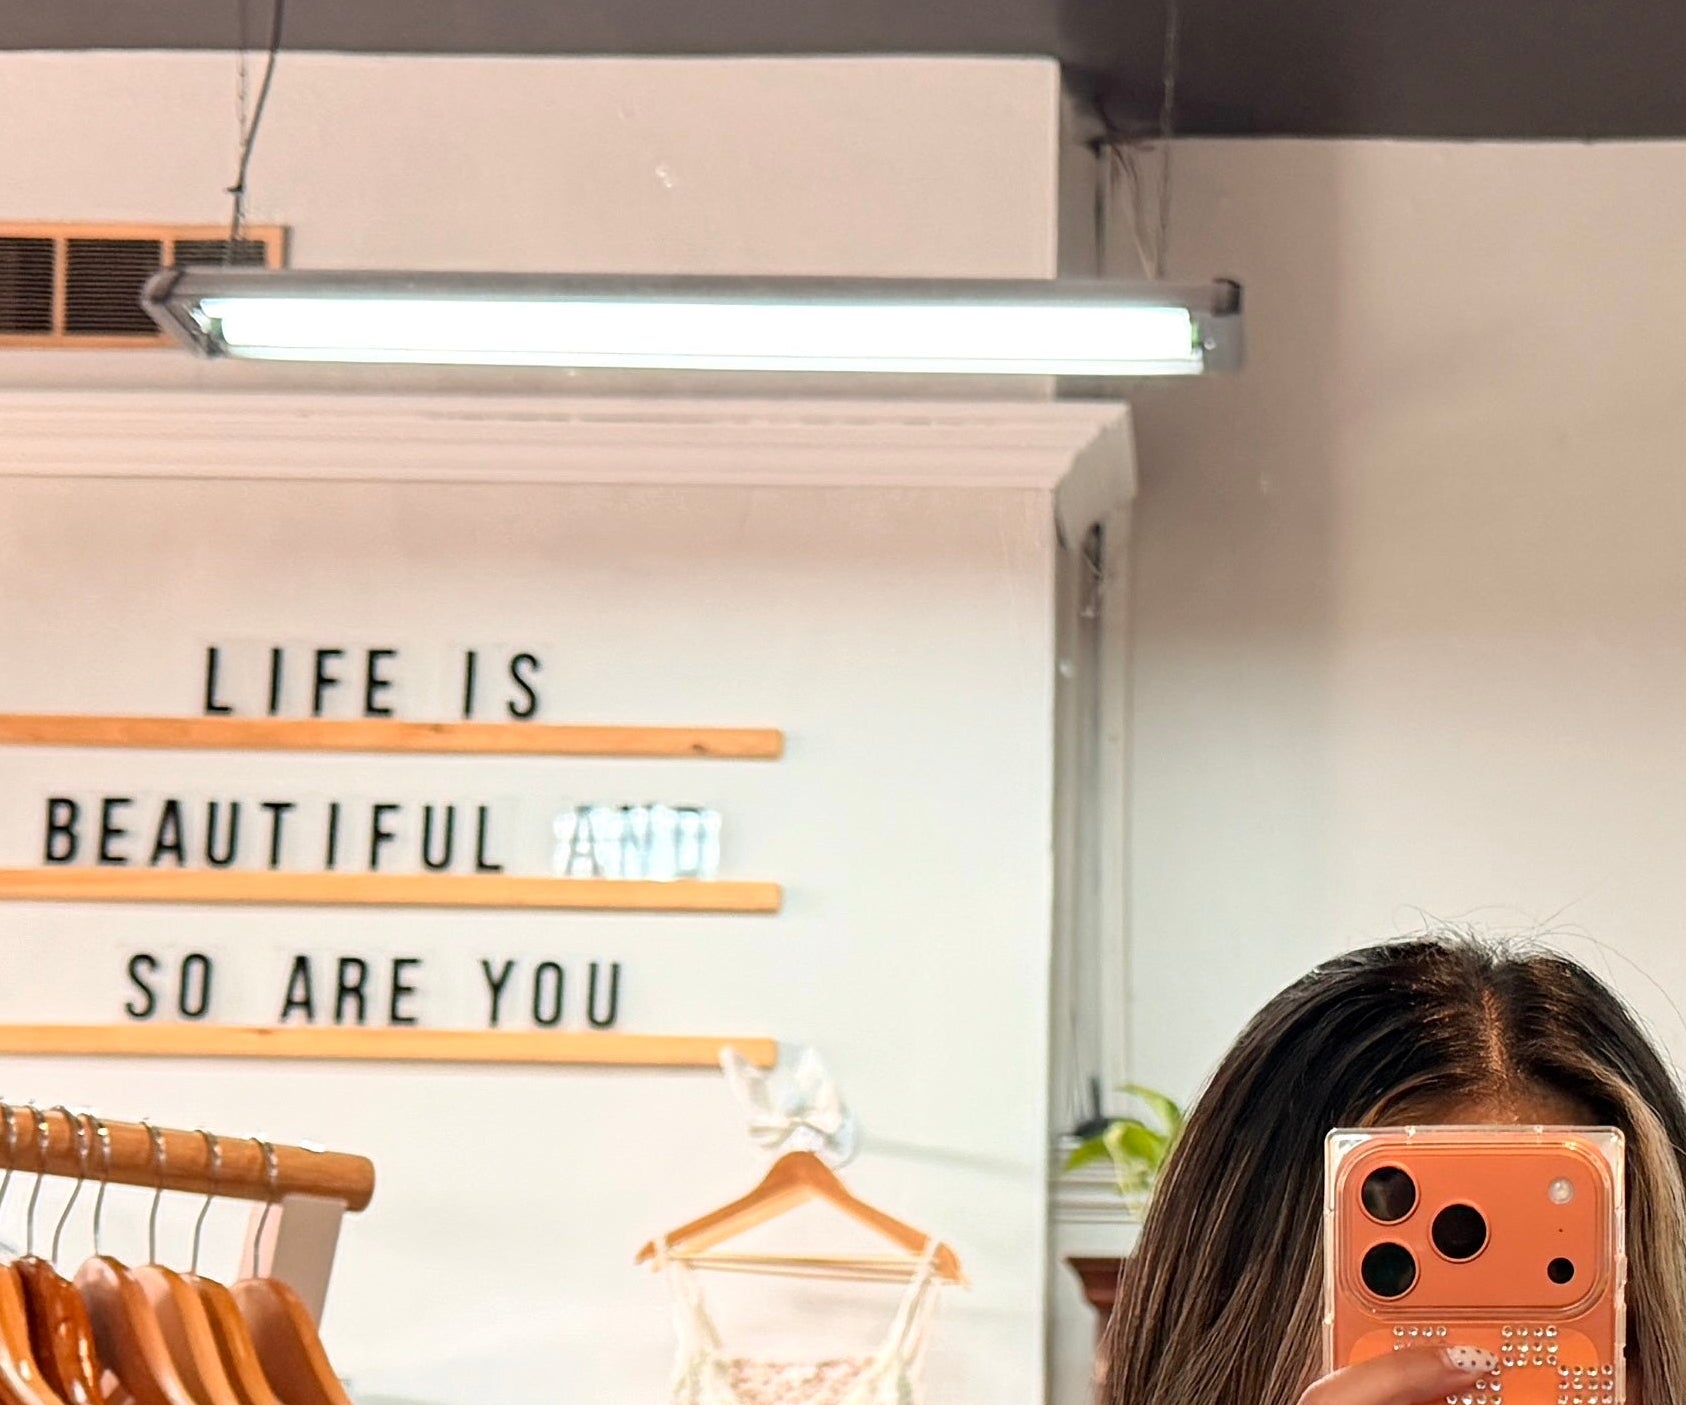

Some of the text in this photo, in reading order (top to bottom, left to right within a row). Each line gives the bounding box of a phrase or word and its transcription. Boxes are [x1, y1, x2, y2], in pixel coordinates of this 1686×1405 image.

[204, 646, 541, 721] LIFE IS
[44, 796, 504, 872] BEAUTIFUL
[125, 952, 621, 1029] SO ARE YOU
